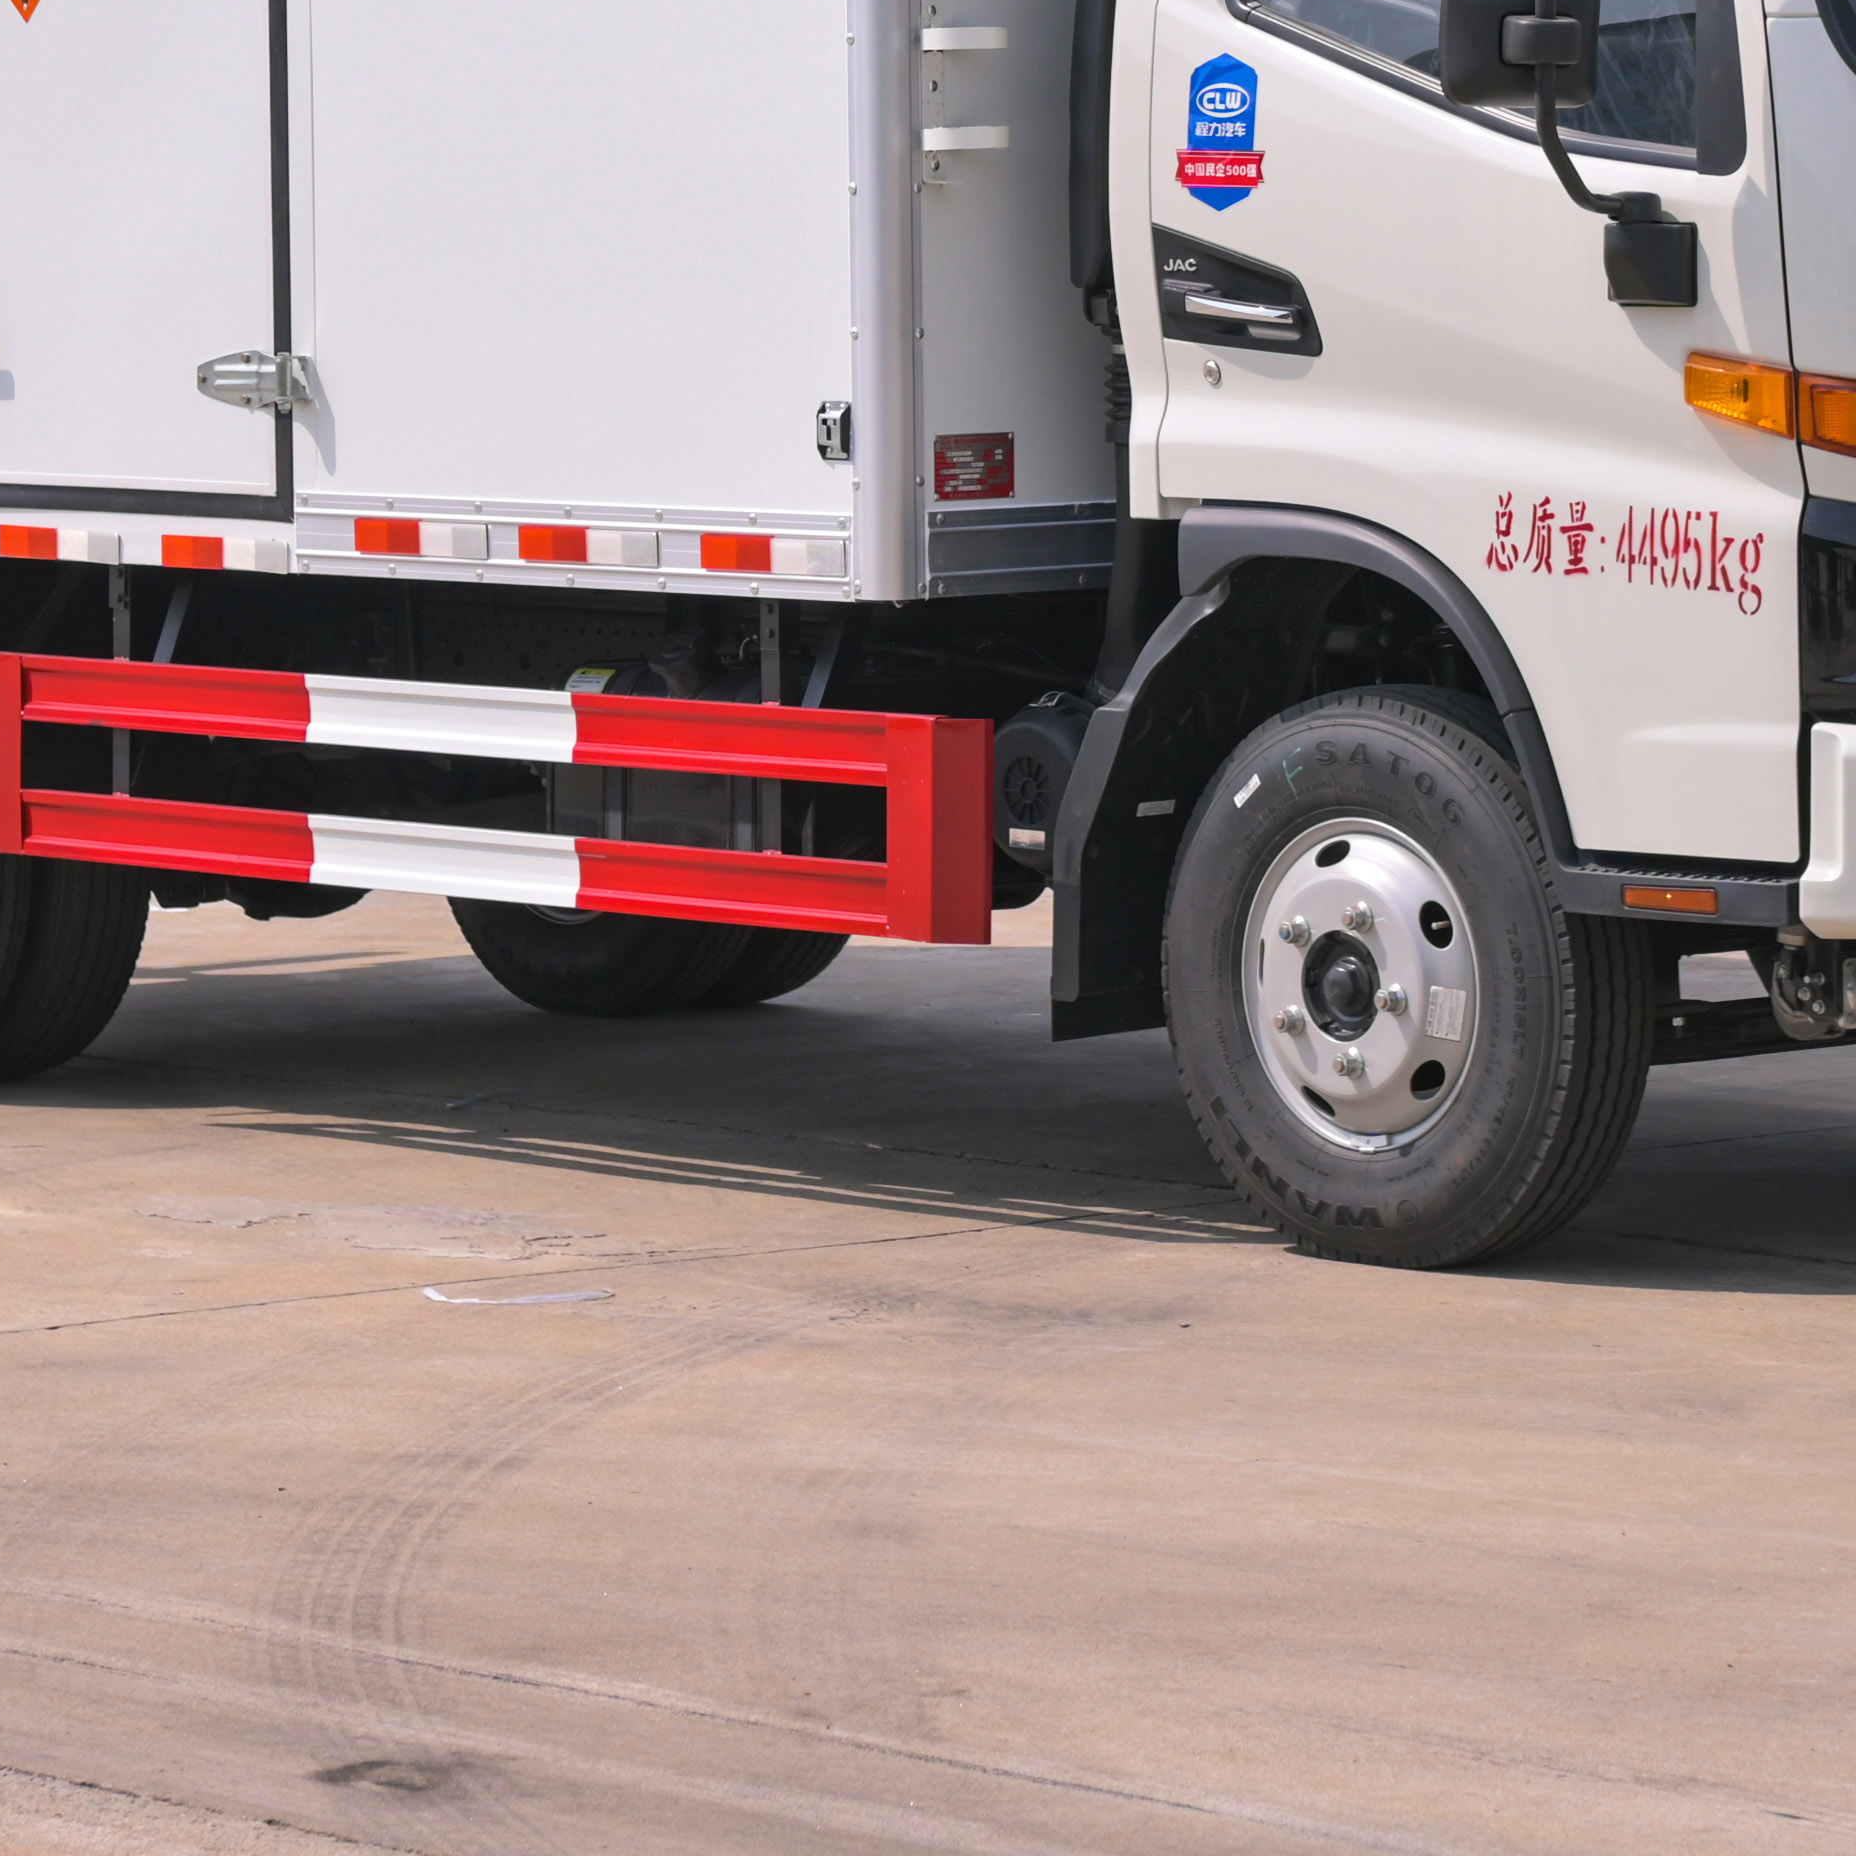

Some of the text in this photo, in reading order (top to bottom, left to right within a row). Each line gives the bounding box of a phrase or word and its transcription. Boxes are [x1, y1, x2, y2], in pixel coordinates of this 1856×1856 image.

[1202, 91, 1242, 110] CLW
[1194, 121, 1247, 138] 程力汽车
[1184, 162, 1257, 178] 中国民企500强
[1163, 258, 1198, 272] JAC
[1208, 1095, 1385, 1231] WANLI
